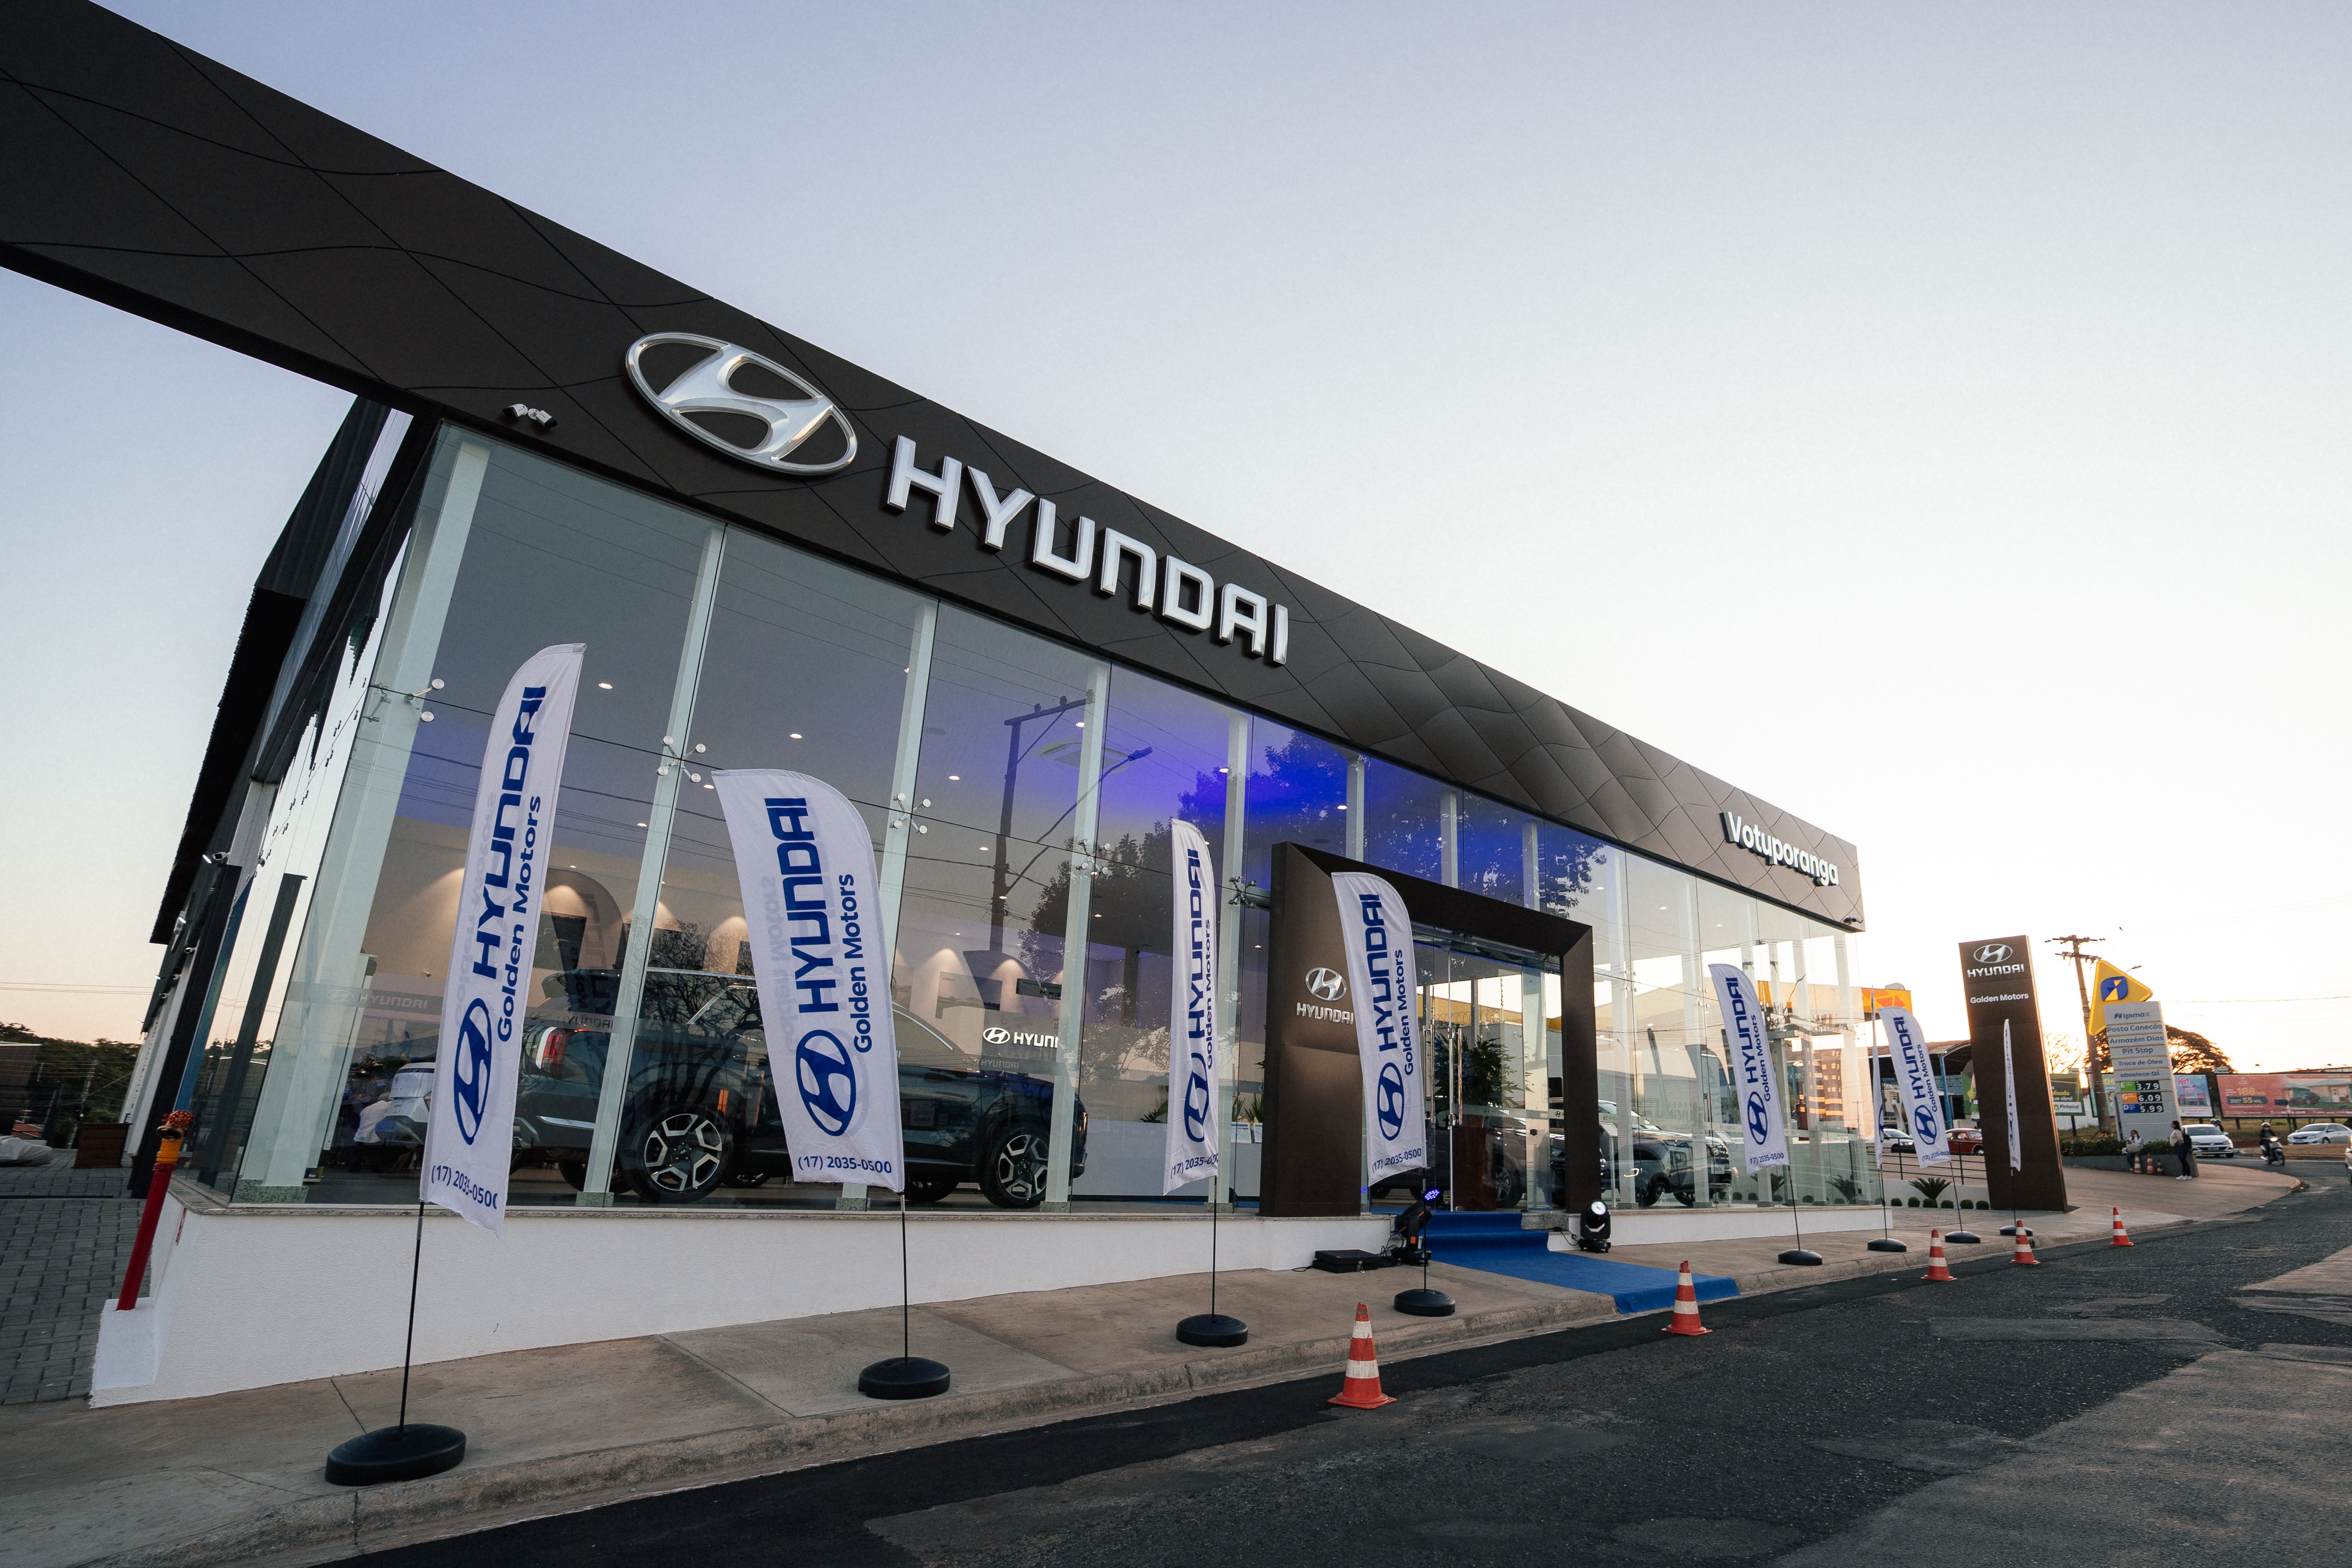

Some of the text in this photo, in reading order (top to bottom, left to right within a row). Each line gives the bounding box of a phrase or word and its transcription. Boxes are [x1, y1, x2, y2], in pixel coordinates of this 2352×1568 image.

[887, 434, 1289, 665] HYUNDAI
[472, 686, 547, 979] HYUNDAI
[1724, 811, 1839, 886] Votuporanga
[497, 796, 540, 1042] Golden Motors
[764, 797, 839, 1013] HYUNDAI
[838, 874, 872, 1053] Golden Motors
[1187, 849, 1205, 1039] HYUNDAI
[1359, 894, 1398, 1052] HYUNDAI
[1967, 964, 2025, 978] HYUNDAI
[359, 993, 427, 1009] HYUNDAI
[1296, 1002, 1354, 1025] HYUNDAI
[1395, 949, 1414, 1076] Golden Motors
[1970, 993, 2029, 1004] Golden Motors
[1013, 1032, 1059, 1048] HYUN
[1725, 977, 1759, 1084] HYUNDAI
[2130, 1023, 2163, 1031] Canecão
[981, 1059, 1019, 1069] HYUNDAI
[1751, 1014, 1771, 1102] Golden Motors
[1893, 1017, 1926, 1099] HYUNDAI
[1917, 1044, 1938, 1112] Golden Motors
[2236, 1087, 2256, 1096] 188
[431, 1165, 452, 1186] (17)
[798, 1156, 892, 1174] (17) 2035-0500
[1170, 1162, 1184, 1178] (17)
[1372, 1148, 1422, 1174] (17) 2035-0500
[1759, 1153, 1784, 1163] 2035-0500
